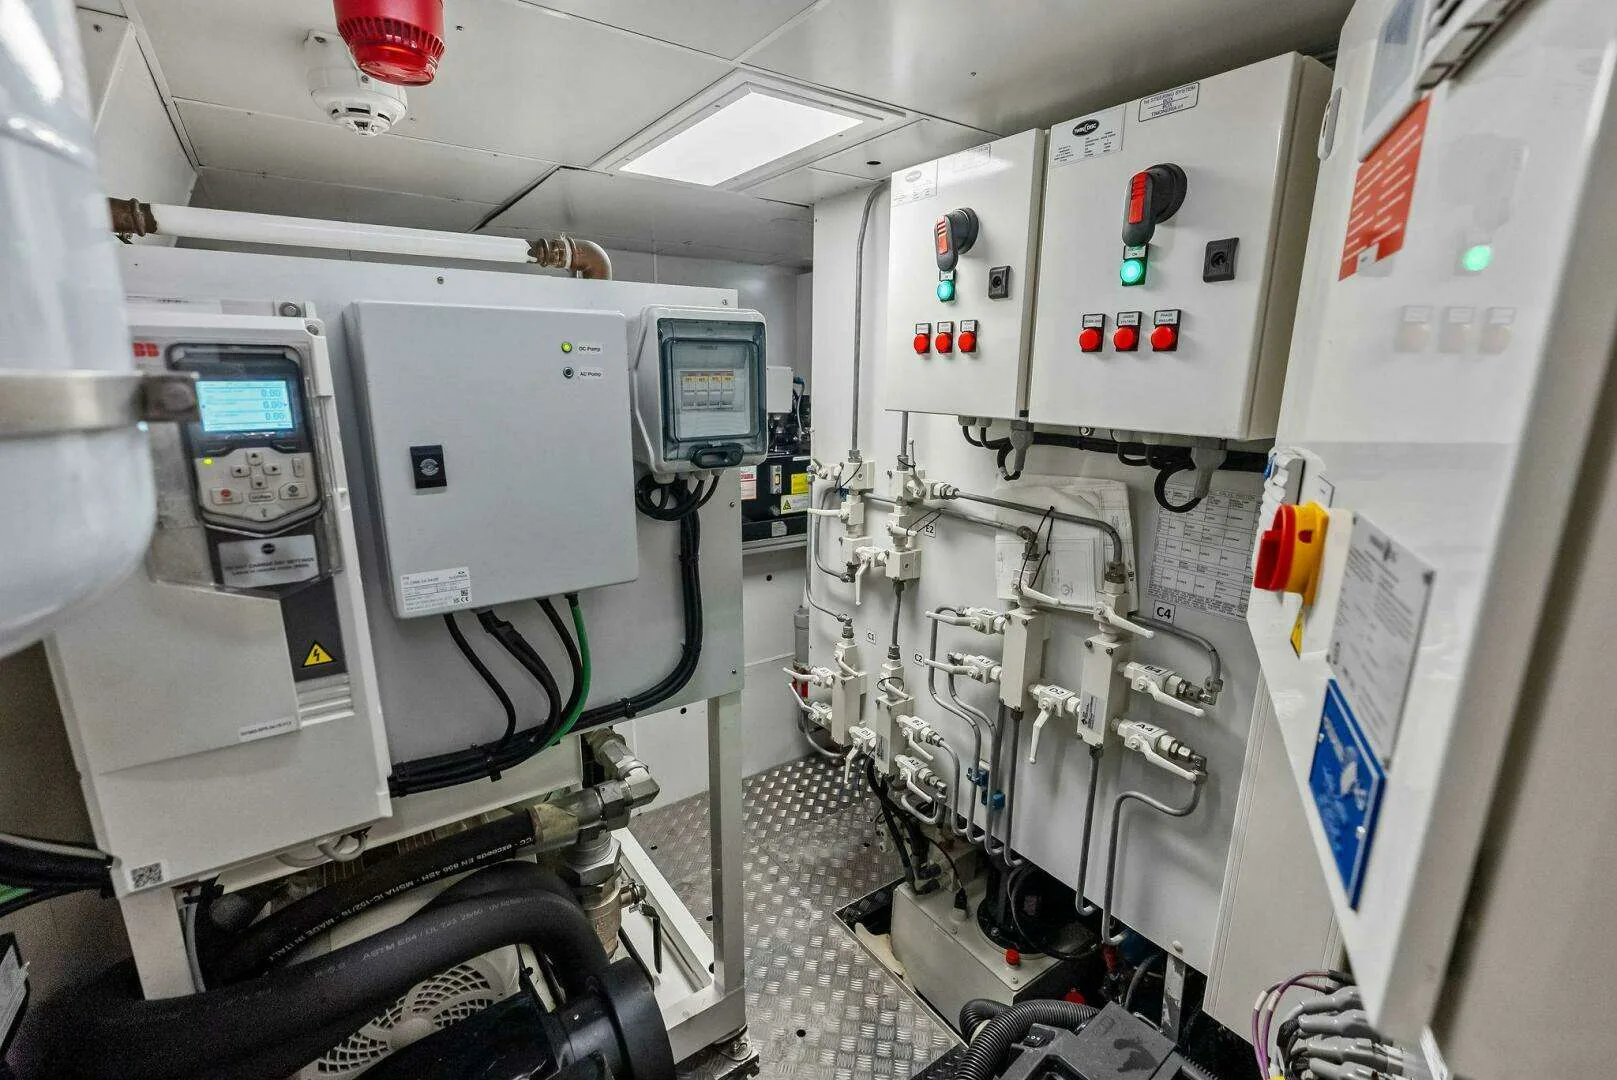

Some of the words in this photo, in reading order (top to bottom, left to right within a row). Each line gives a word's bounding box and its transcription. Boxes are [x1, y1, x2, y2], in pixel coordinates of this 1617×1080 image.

[925, 524, 934, 533] E2
[1157, 607, 1171, 619] C4
[915, 654, 922, 663] C2
[1136, 724, 1153, 732] A4
[475, 843, 512, 860] exceeds
[460, 856, 474, 866] EN
[304, 916, 335, 937] MADE
